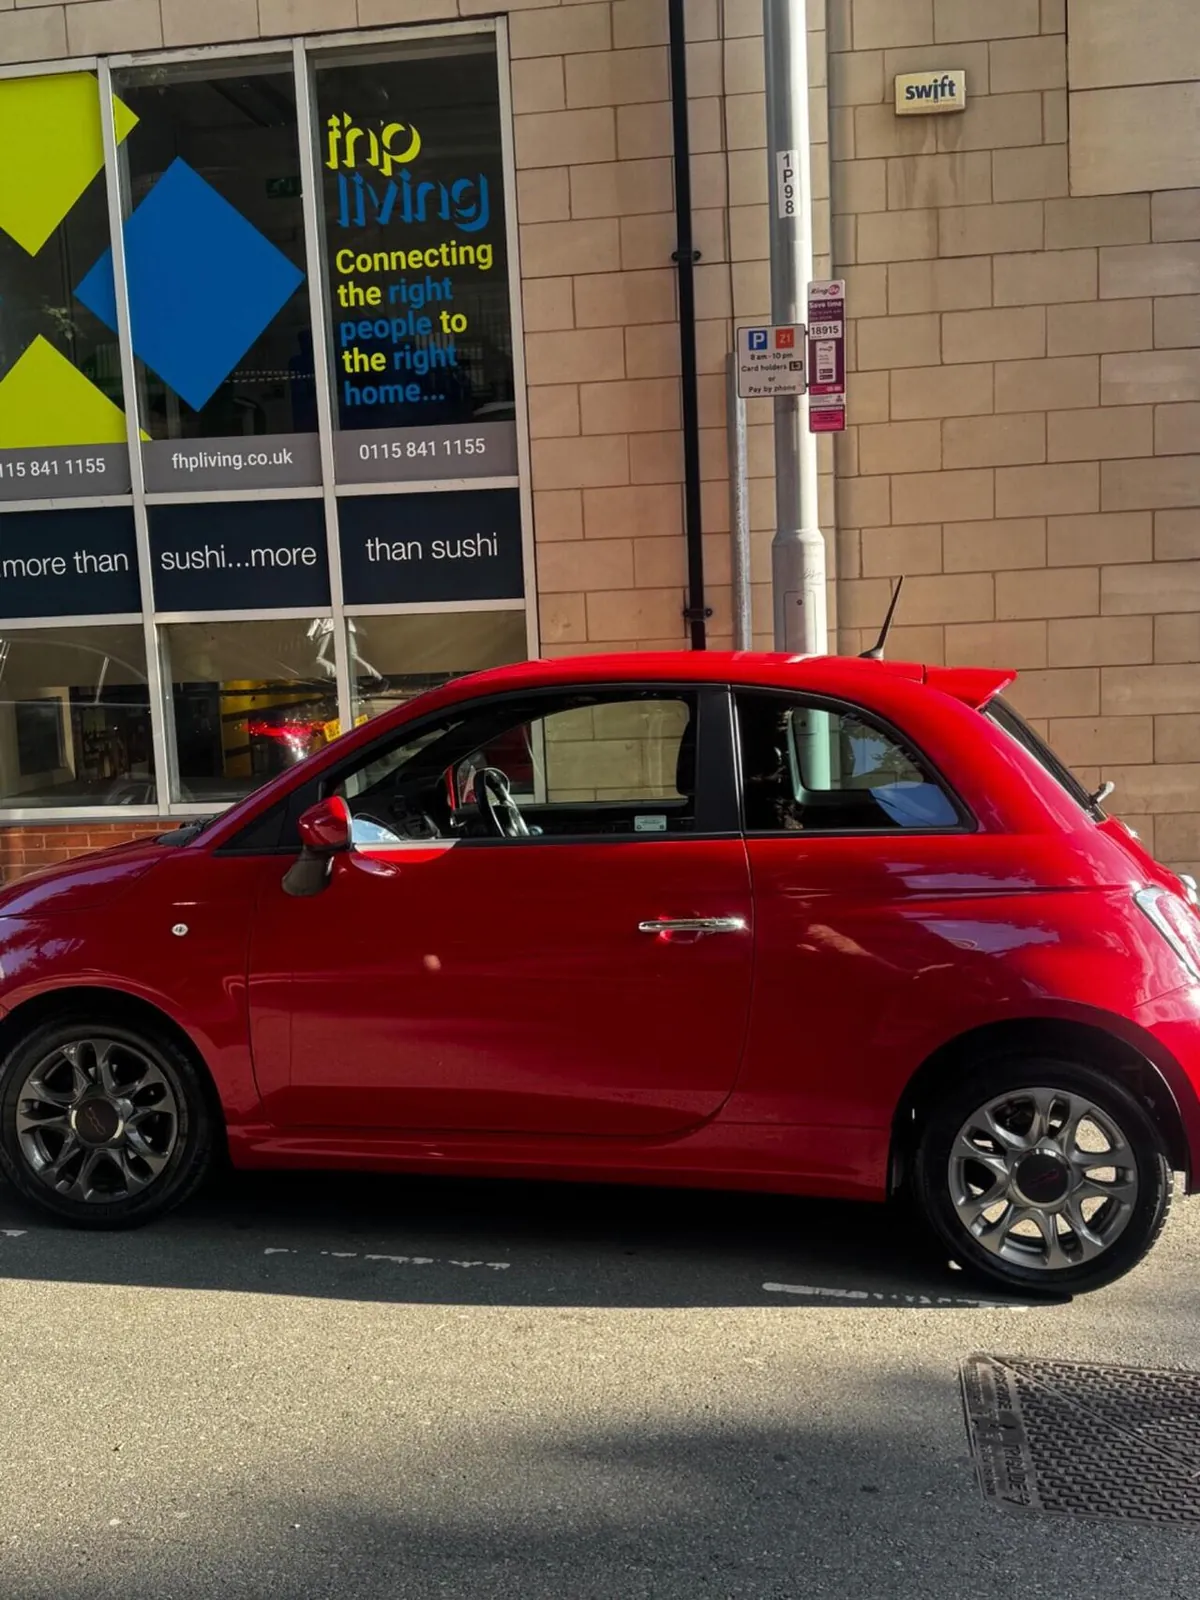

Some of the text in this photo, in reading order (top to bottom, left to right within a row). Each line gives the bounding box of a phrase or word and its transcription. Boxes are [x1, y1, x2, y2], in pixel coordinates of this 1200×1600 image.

[905, 75, 956, 103] swift
[336, 168, 490, 233] living
[335, 240, 493, 274] Connecting
[337, 275, 454, 309] the right
[340, 310, 468, 347] people to
[753, 332, 765, 349] P
[811, 325, 839, 335] 18915
[342, 341, 458, 375] the right
[760, 363, 787, 371] holders
[782, 352, 794, 360] pm
[343, 380, 445, 406] home...
[763, 385, 773, 393] by
[171, 448, 293, 472] fhpliving.co.uk
[359, 438, 486, 460] 0115 841 1155
[30, 460, 59, 477] 841
[65, 458, 106, 475] 1155
[365, 532, 498, 562] than sushi
[73, 550, 129, 574] than
